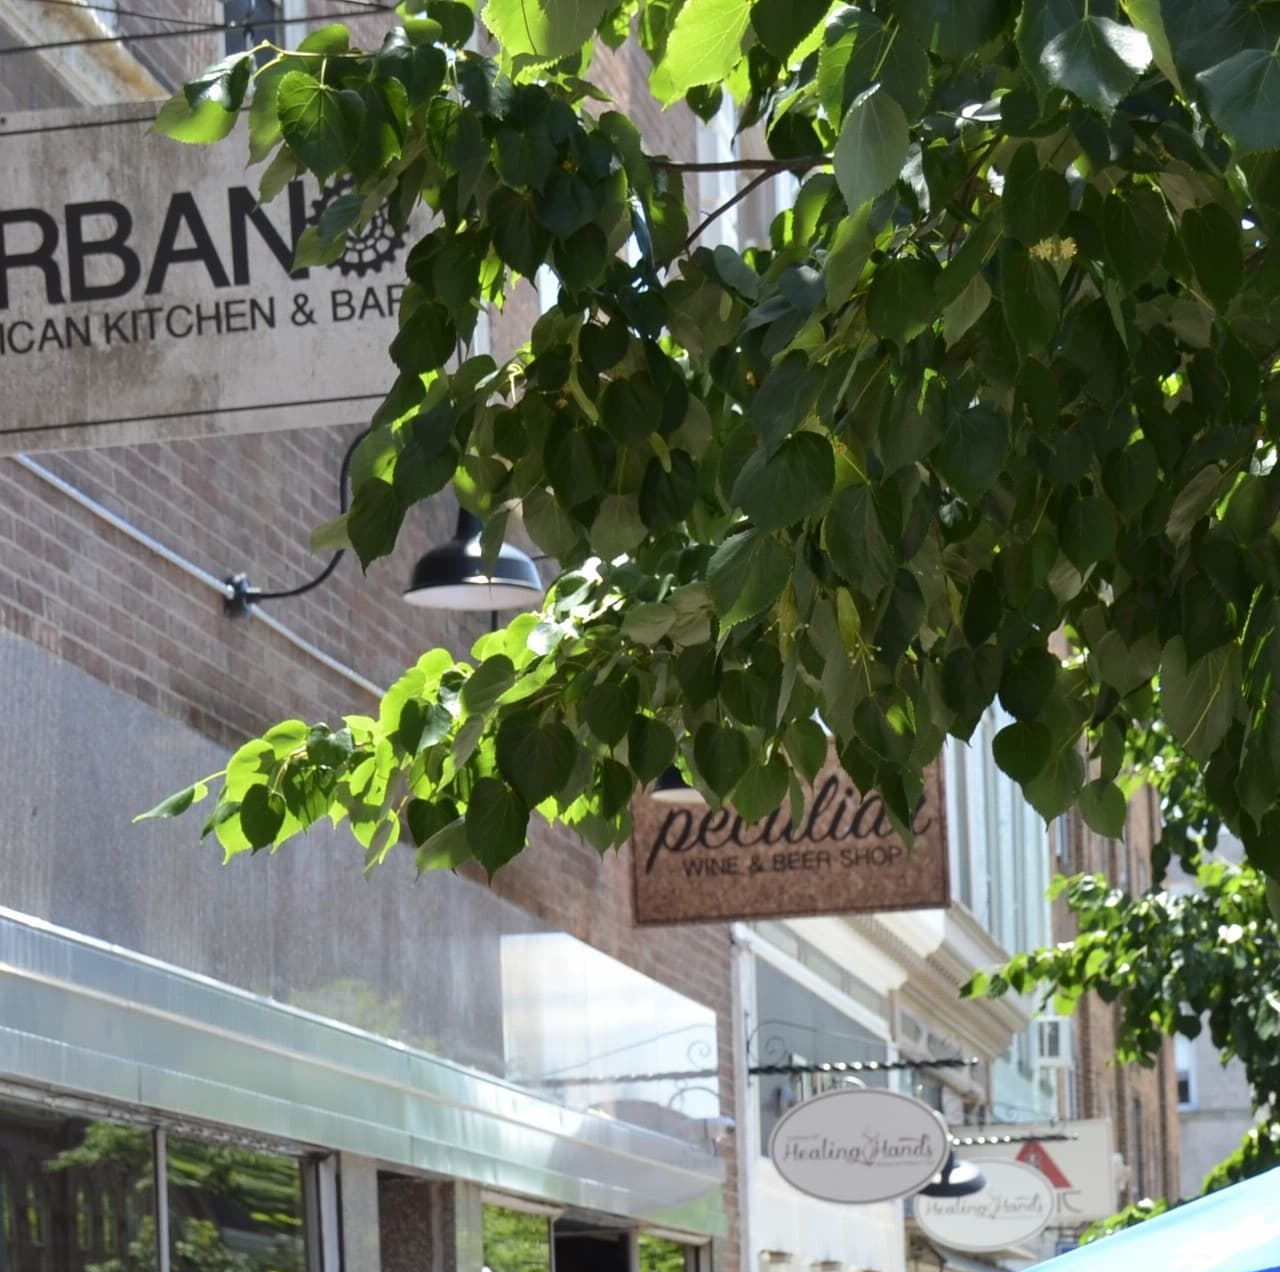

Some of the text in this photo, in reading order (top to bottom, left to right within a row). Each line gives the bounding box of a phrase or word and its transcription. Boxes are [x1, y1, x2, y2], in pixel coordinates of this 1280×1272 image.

[104, 296, 276, 346] KITCHEN
[290, 294, 317, 325] &
[682, 845, 902, 879] WINE & BEER SHOP
[783, 1133, 934, 1164] Healing Hands
[925, 1193, 1043, 1217] Healing Hands
